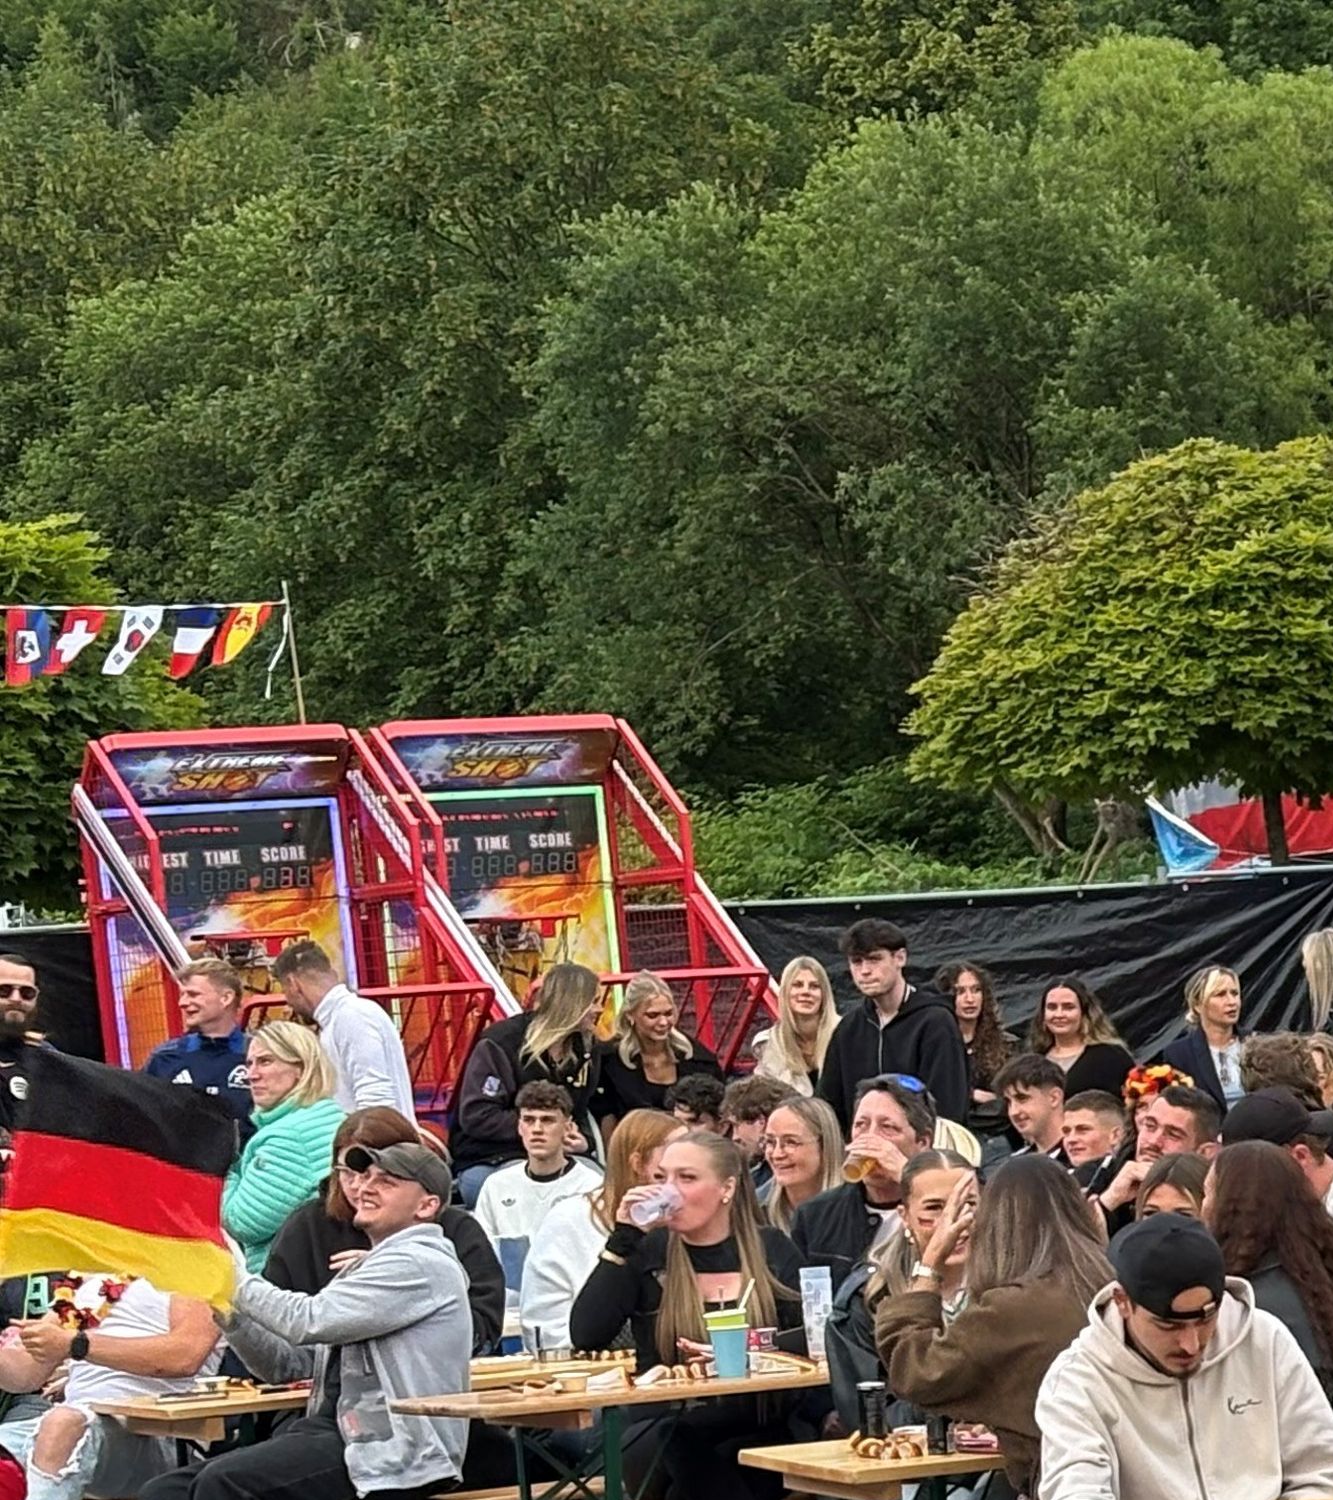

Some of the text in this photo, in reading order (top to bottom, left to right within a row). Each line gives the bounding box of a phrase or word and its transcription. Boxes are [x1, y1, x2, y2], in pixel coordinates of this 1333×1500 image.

[453, 739, 559, 758] EXTREME
[174, 753, 287, 770] EXTREME
[451, 758, 547, 779] SHOT
[172, 771, 278, 791] SHOT
[474, 835, 510, 852] TIME
[528, 831, 573, 848] SCORE
[203, 849, 241, 867] TIME
[260, 845, 307, 862] SCORE
